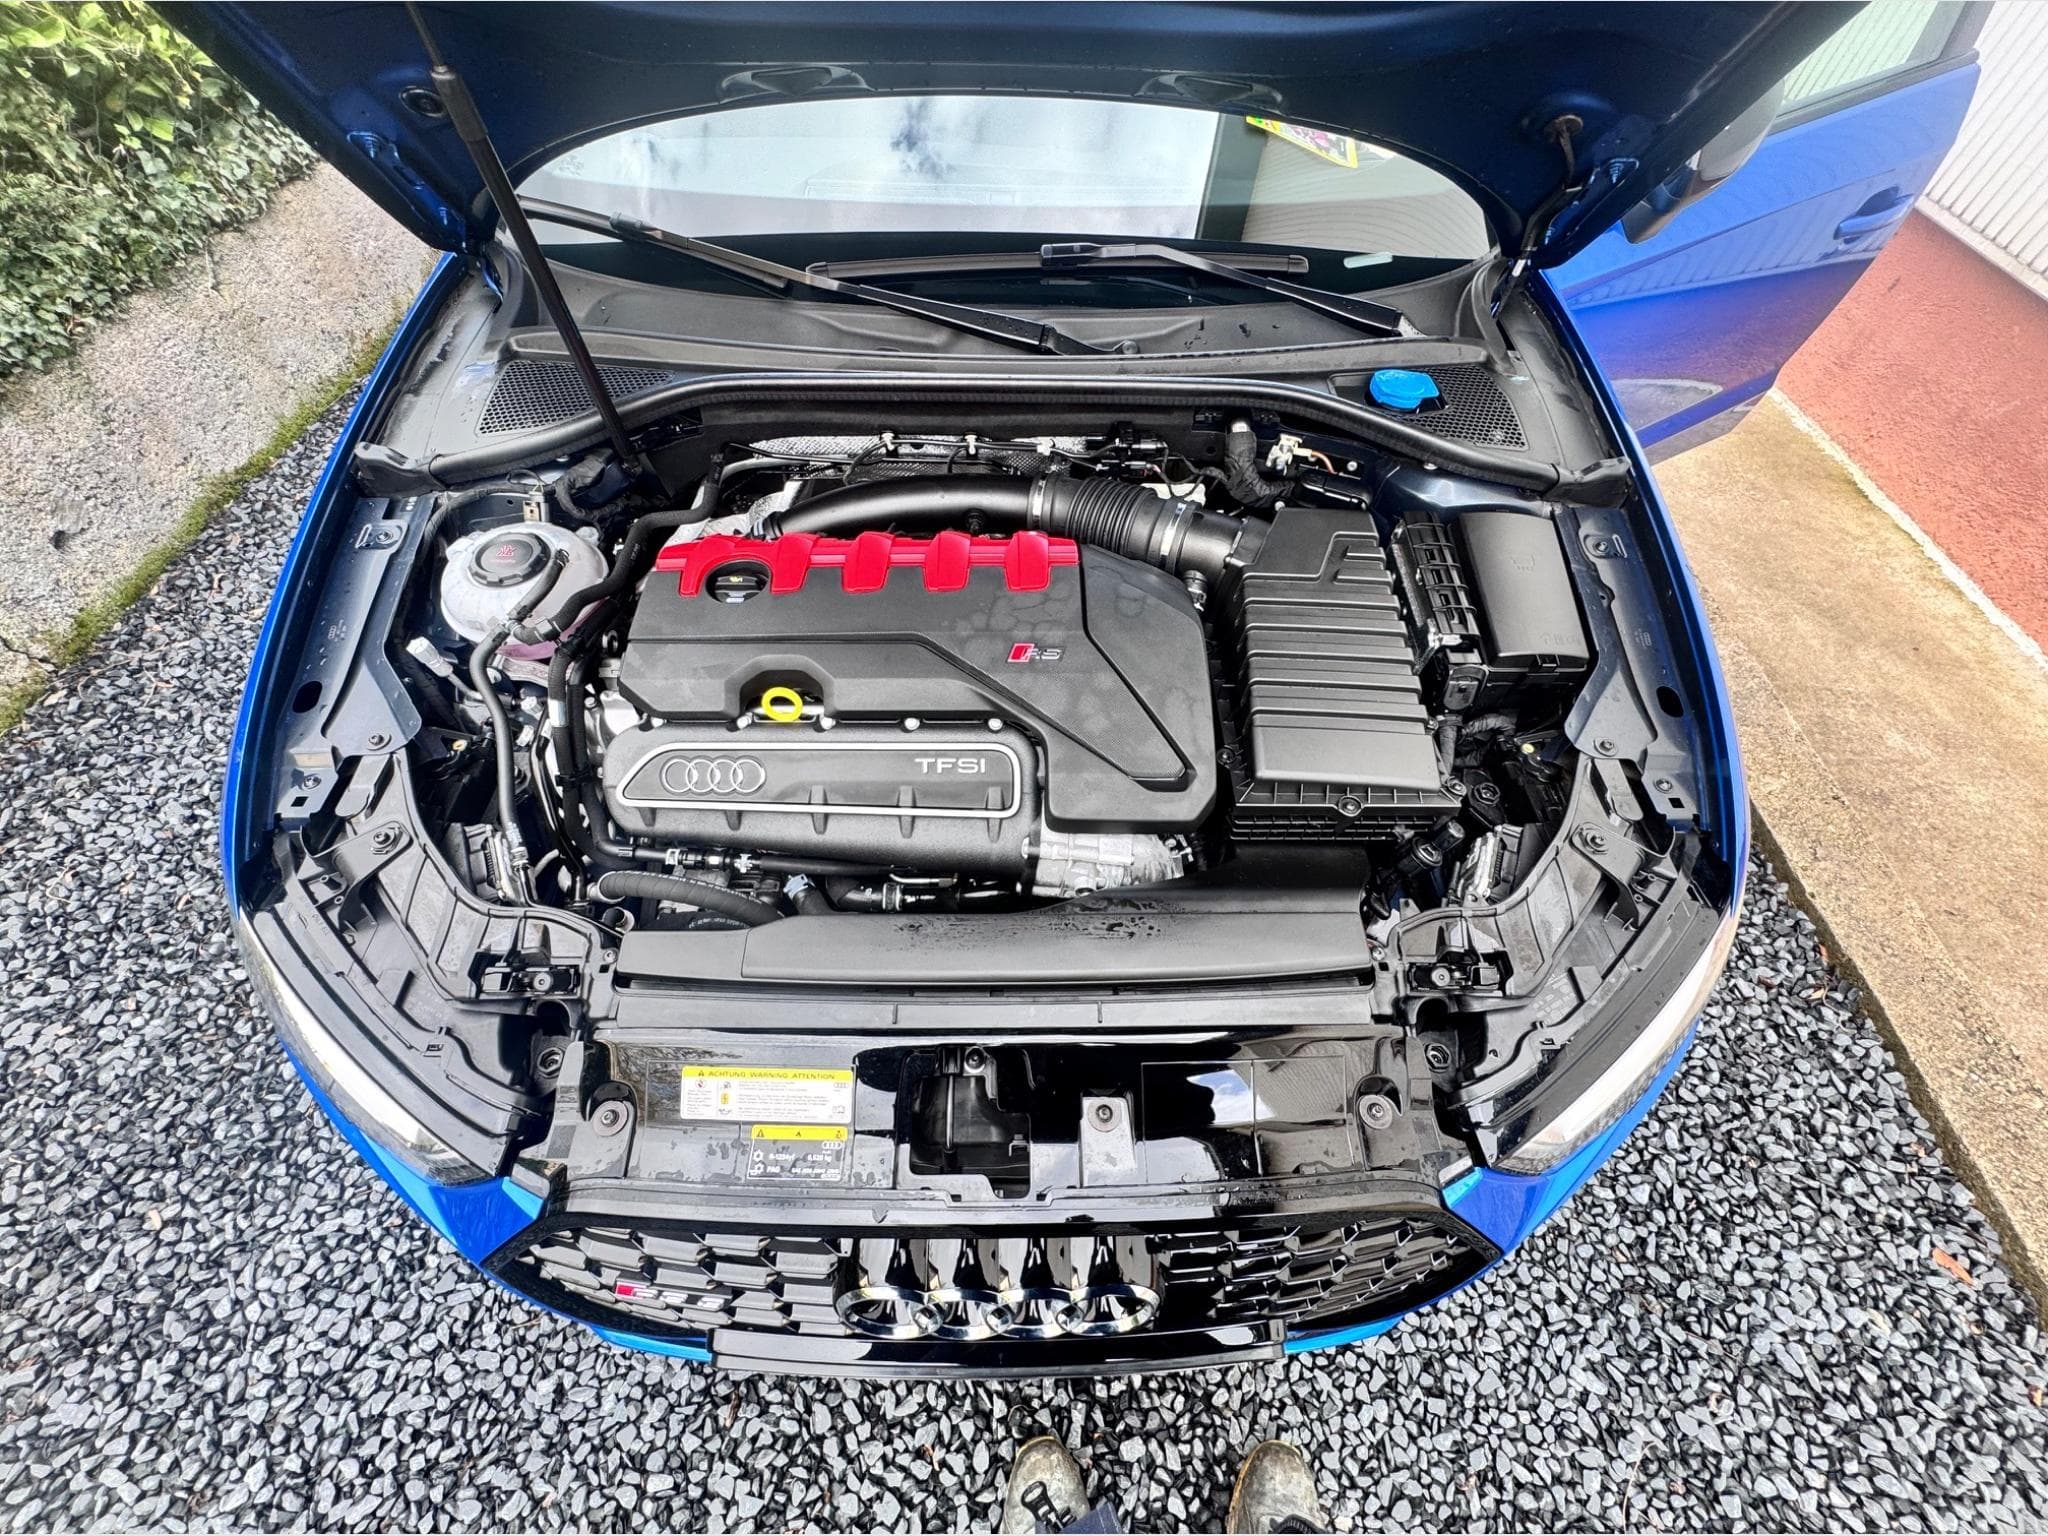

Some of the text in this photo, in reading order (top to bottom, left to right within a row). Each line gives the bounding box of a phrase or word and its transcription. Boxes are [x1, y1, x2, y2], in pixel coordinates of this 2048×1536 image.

[1018, 646, 1062, 661] RS
[914, 757, 986, 774] TFSI
[708, 1071, 836, 1081] ACHTUNG WARNING ATTENTION
